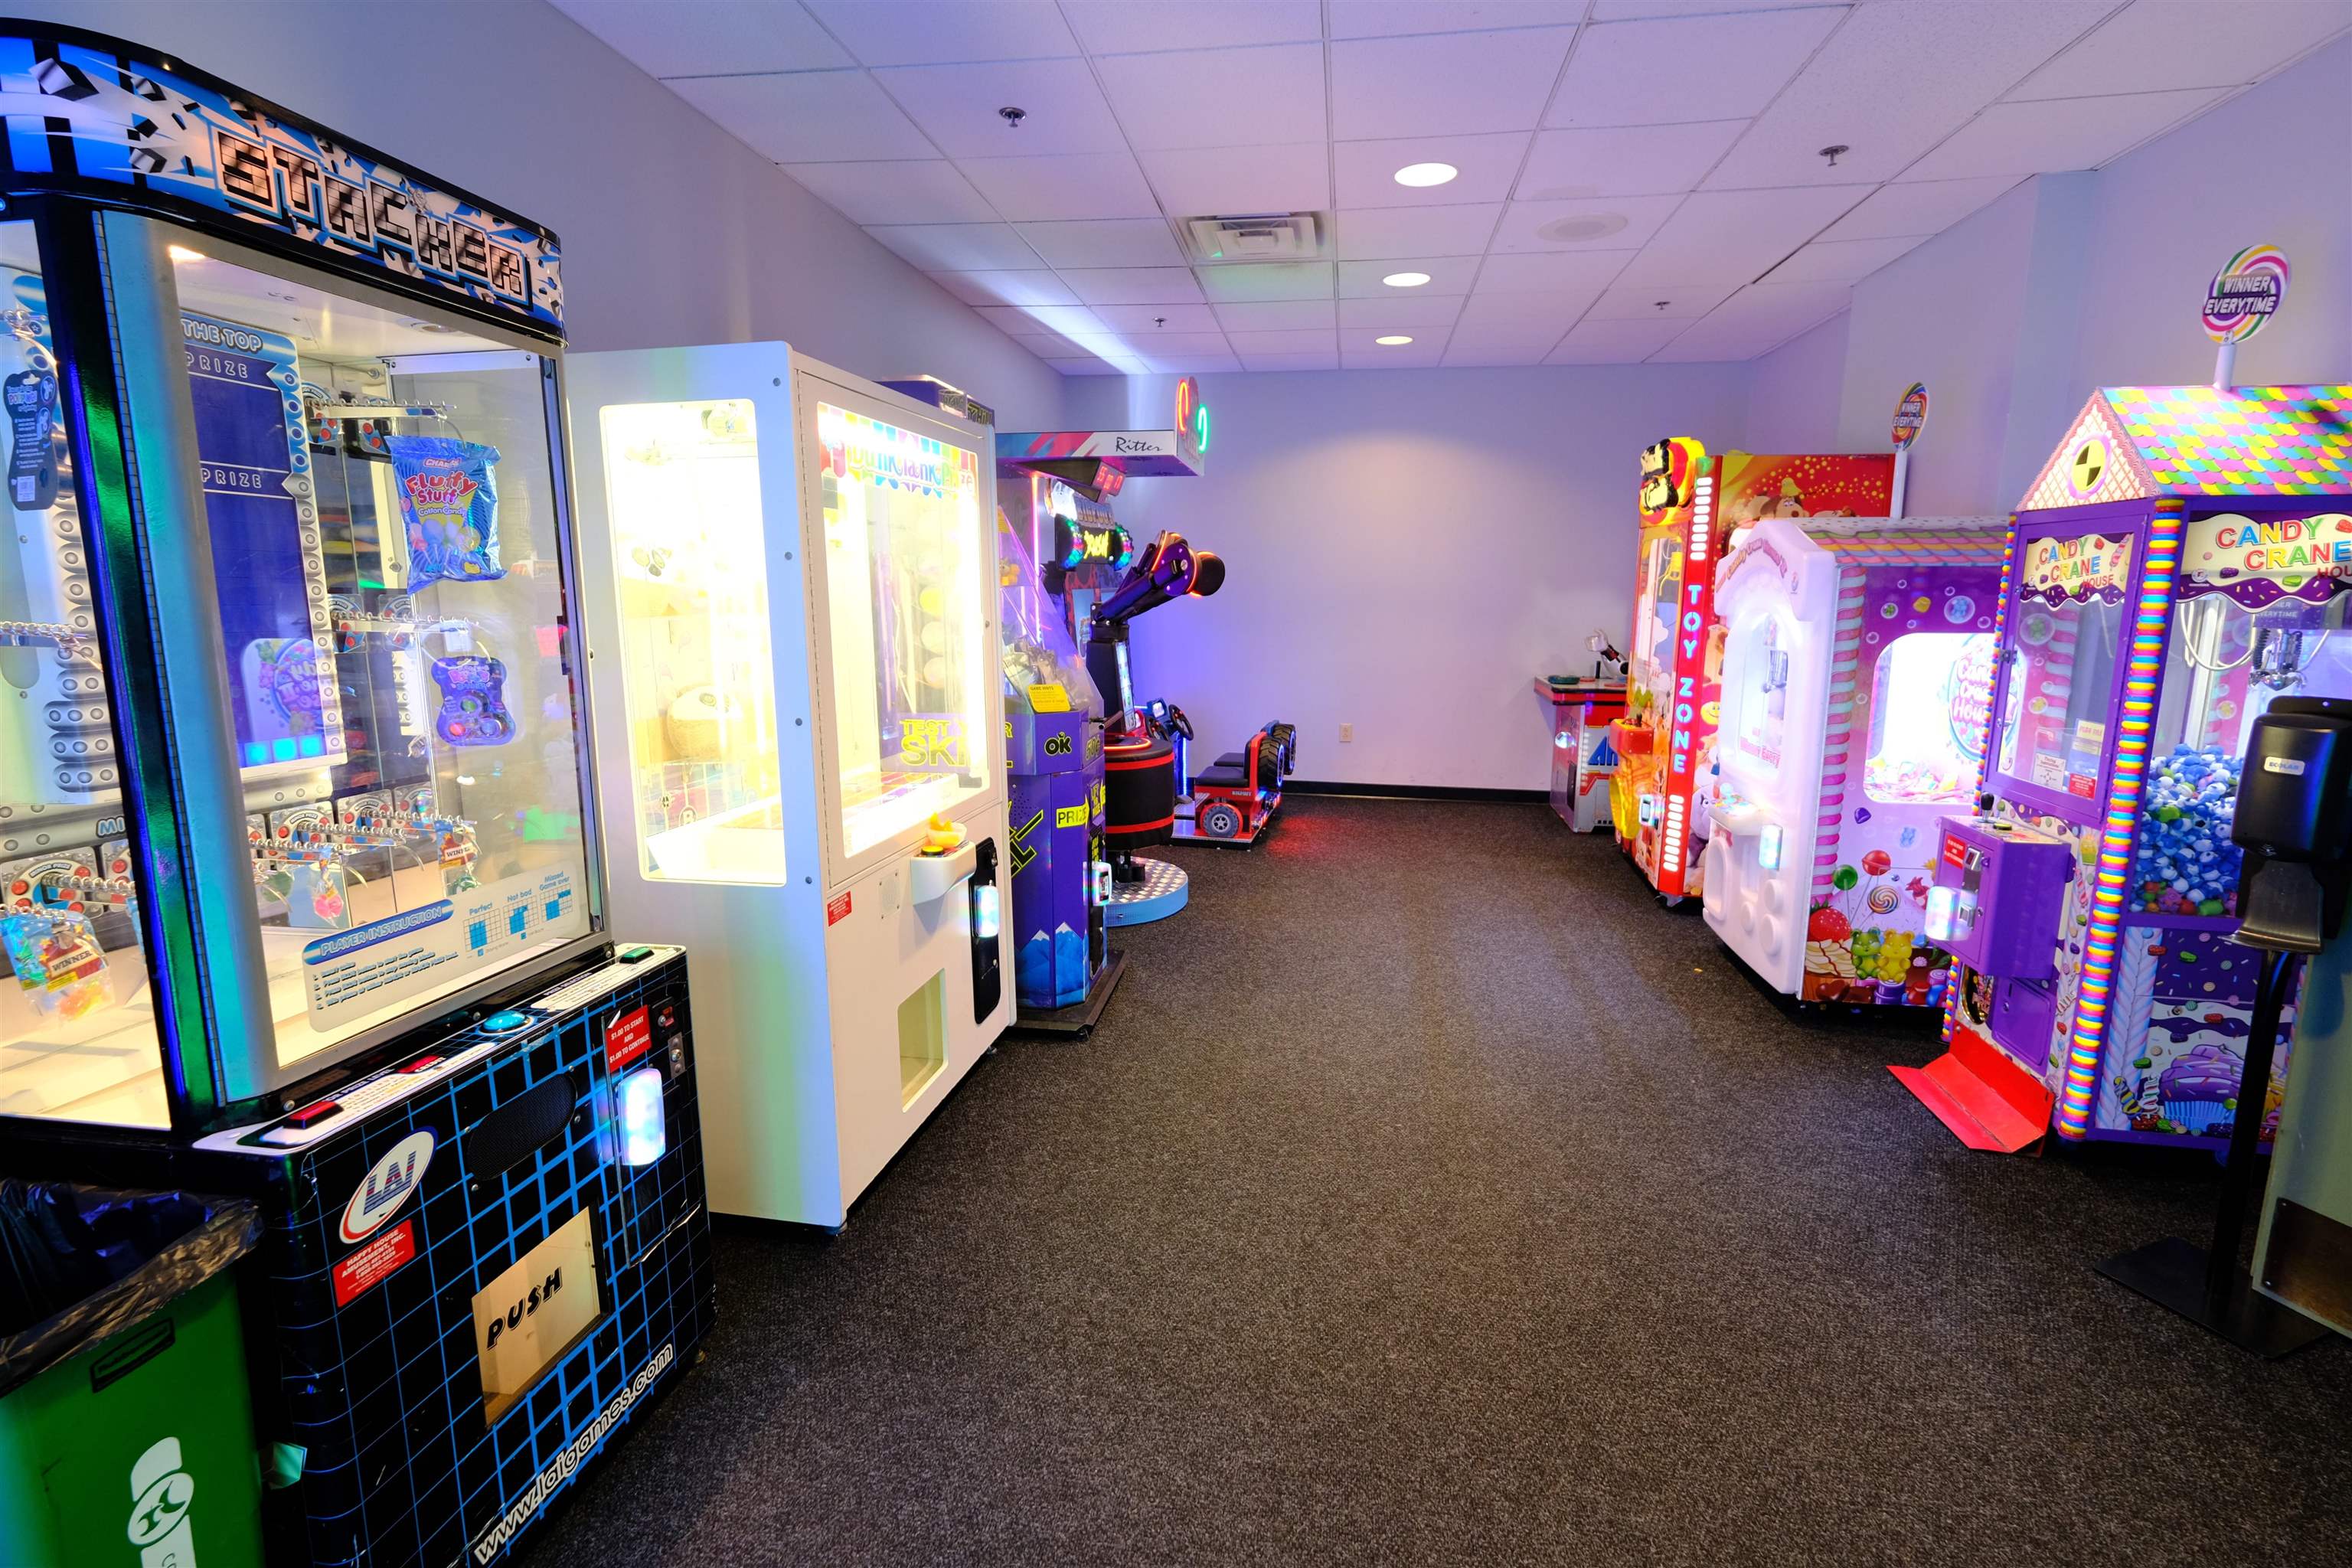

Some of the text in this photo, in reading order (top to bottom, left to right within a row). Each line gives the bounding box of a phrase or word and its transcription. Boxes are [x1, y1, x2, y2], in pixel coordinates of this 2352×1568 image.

[218, 131, 522, 295] STACKER
[2223, 276, 2271, 293] WINNER
[2205, 296, 2276, 313] EVERYTIME
[181, 318, 263, 353] THE TOP
[185, 351, 248, 378] PRIZE
[201, 468, 262, 488] PRIZE
[405, 471, 478, 496] Fluffy
[416, 490, 458, 505] Stuff
[418, 507, 443, 516] Cotton
[2216, 518, 2324, 550] CANDY
[2039, 537, 2089, 565] CANDY
[2244, 540, 2352, 570] CRANE
[2050, 555, 2101, 583] CRANE
[2082, 574, 2114, 588] HOUSE
[1674, 584, 1702, 773] TOY ZONE
[900, 718, 951, 737] TEST
[507, 888, 531, 902] Not bad
[469, 902, 492, 915] Perfect
[321, 906, 442, 956] PLAYER INSTRUCTION
[52, 951, 92, 971] WINNER
[611, 1015, 644, 1040] $1.00 TO START
[624, 1032, 633, 1043] AND
[622, 1047, 629, 1056] TO
[629, 1034, 649, 1052] CONTINUE
[347, 1246, 372, 1266] HAPPY
[374, 1229, 399, 1250] HOUSE
[486, 1266, 563, 1351] PUSH
[474, 1343, 674, 1565] www.laigames.com
